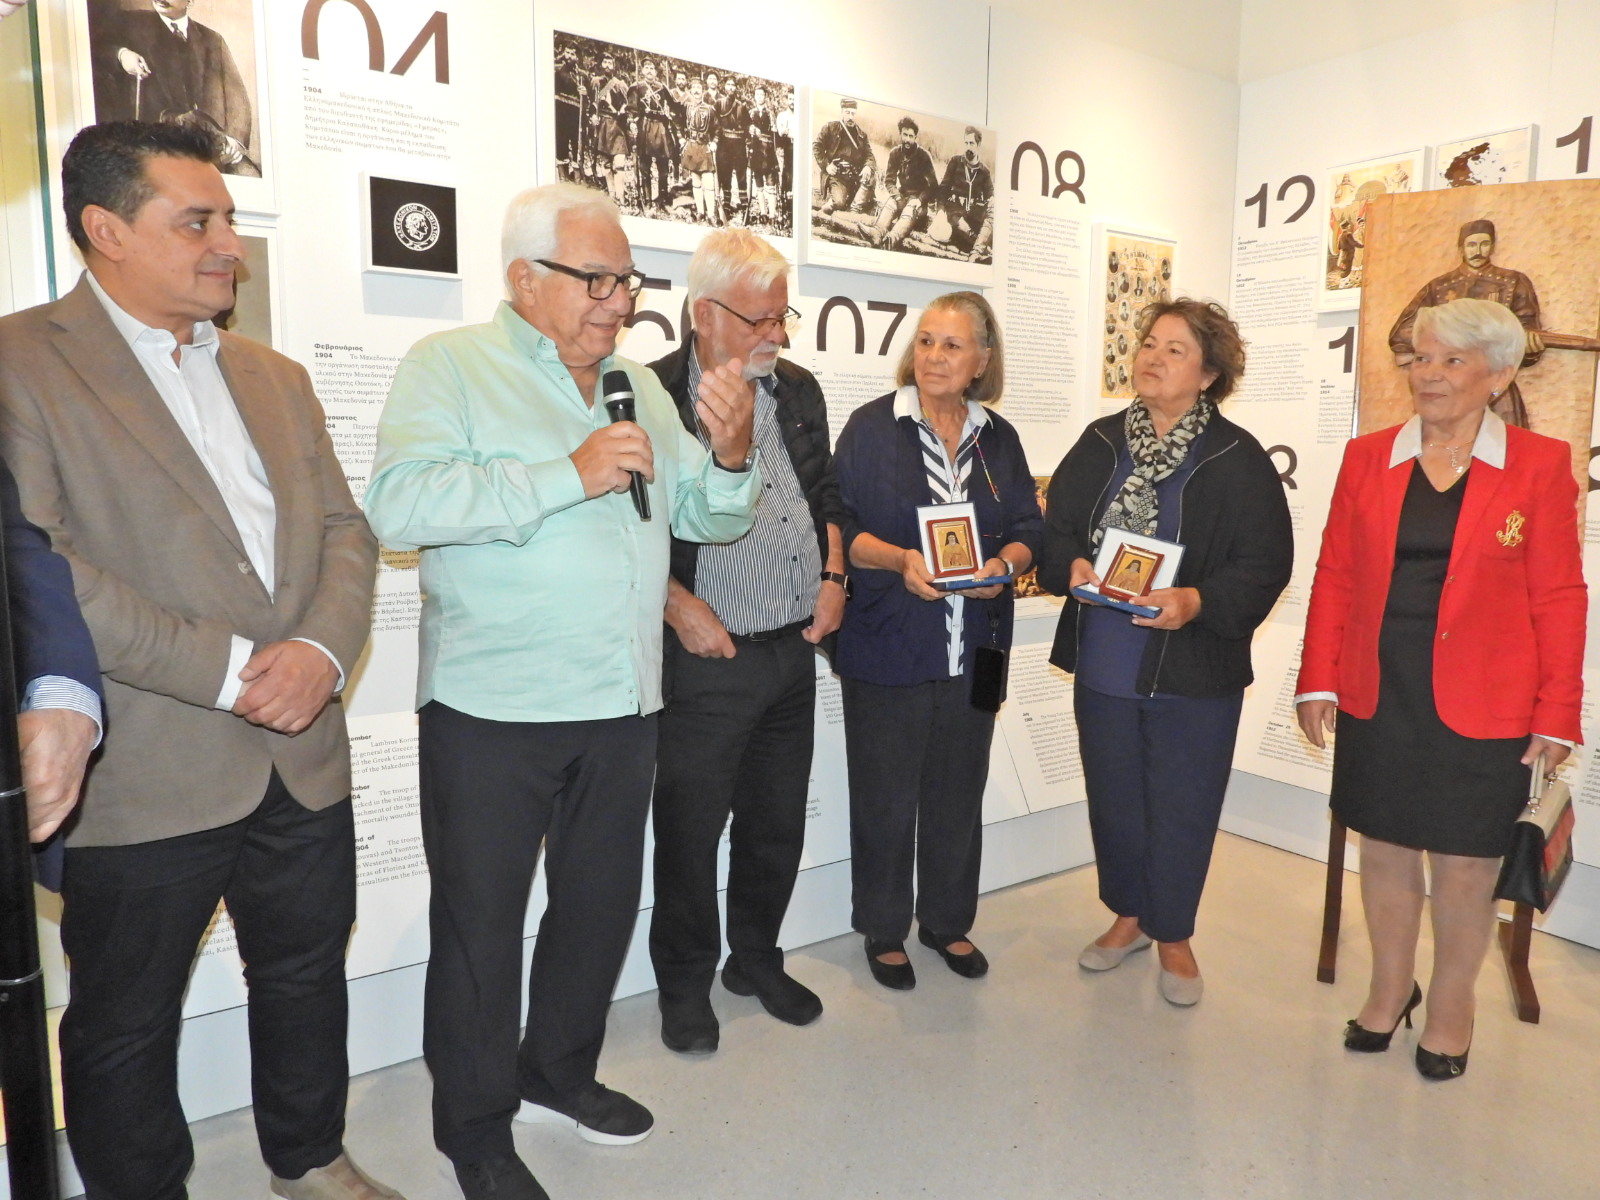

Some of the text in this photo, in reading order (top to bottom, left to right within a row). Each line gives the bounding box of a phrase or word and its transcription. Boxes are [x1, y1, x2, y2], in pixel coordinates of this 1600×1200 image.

[304, 86, 322, 94] 1904
[314, 343, 363, 352] Φεβρουάριος
[359, 354, 396, 362] Μακεδονικό
[328, 362, 359, 370] οργάνωση
[354, 371, 387, 379] Μακεδονία
[360, 750, 382, 758] general
[392, 745, 413, 753] Greece
[373, 756, 391, 764] Greek
[353, 808, 384, 817] tachment
[361, 815, 388, 825] mortally
[401, 836, 421, 844] troops
[356, 852, 379, 860] ouvas)
[394, 845, 418, 853] Tsontos
[362, 860, 389, 868] Western
[391, 853, 426, 862] Macedonia
[383, 864, 406, 873] Florina
[357, 877, 390, 887] casualties
[217, 945, 237, 953] Kasto
